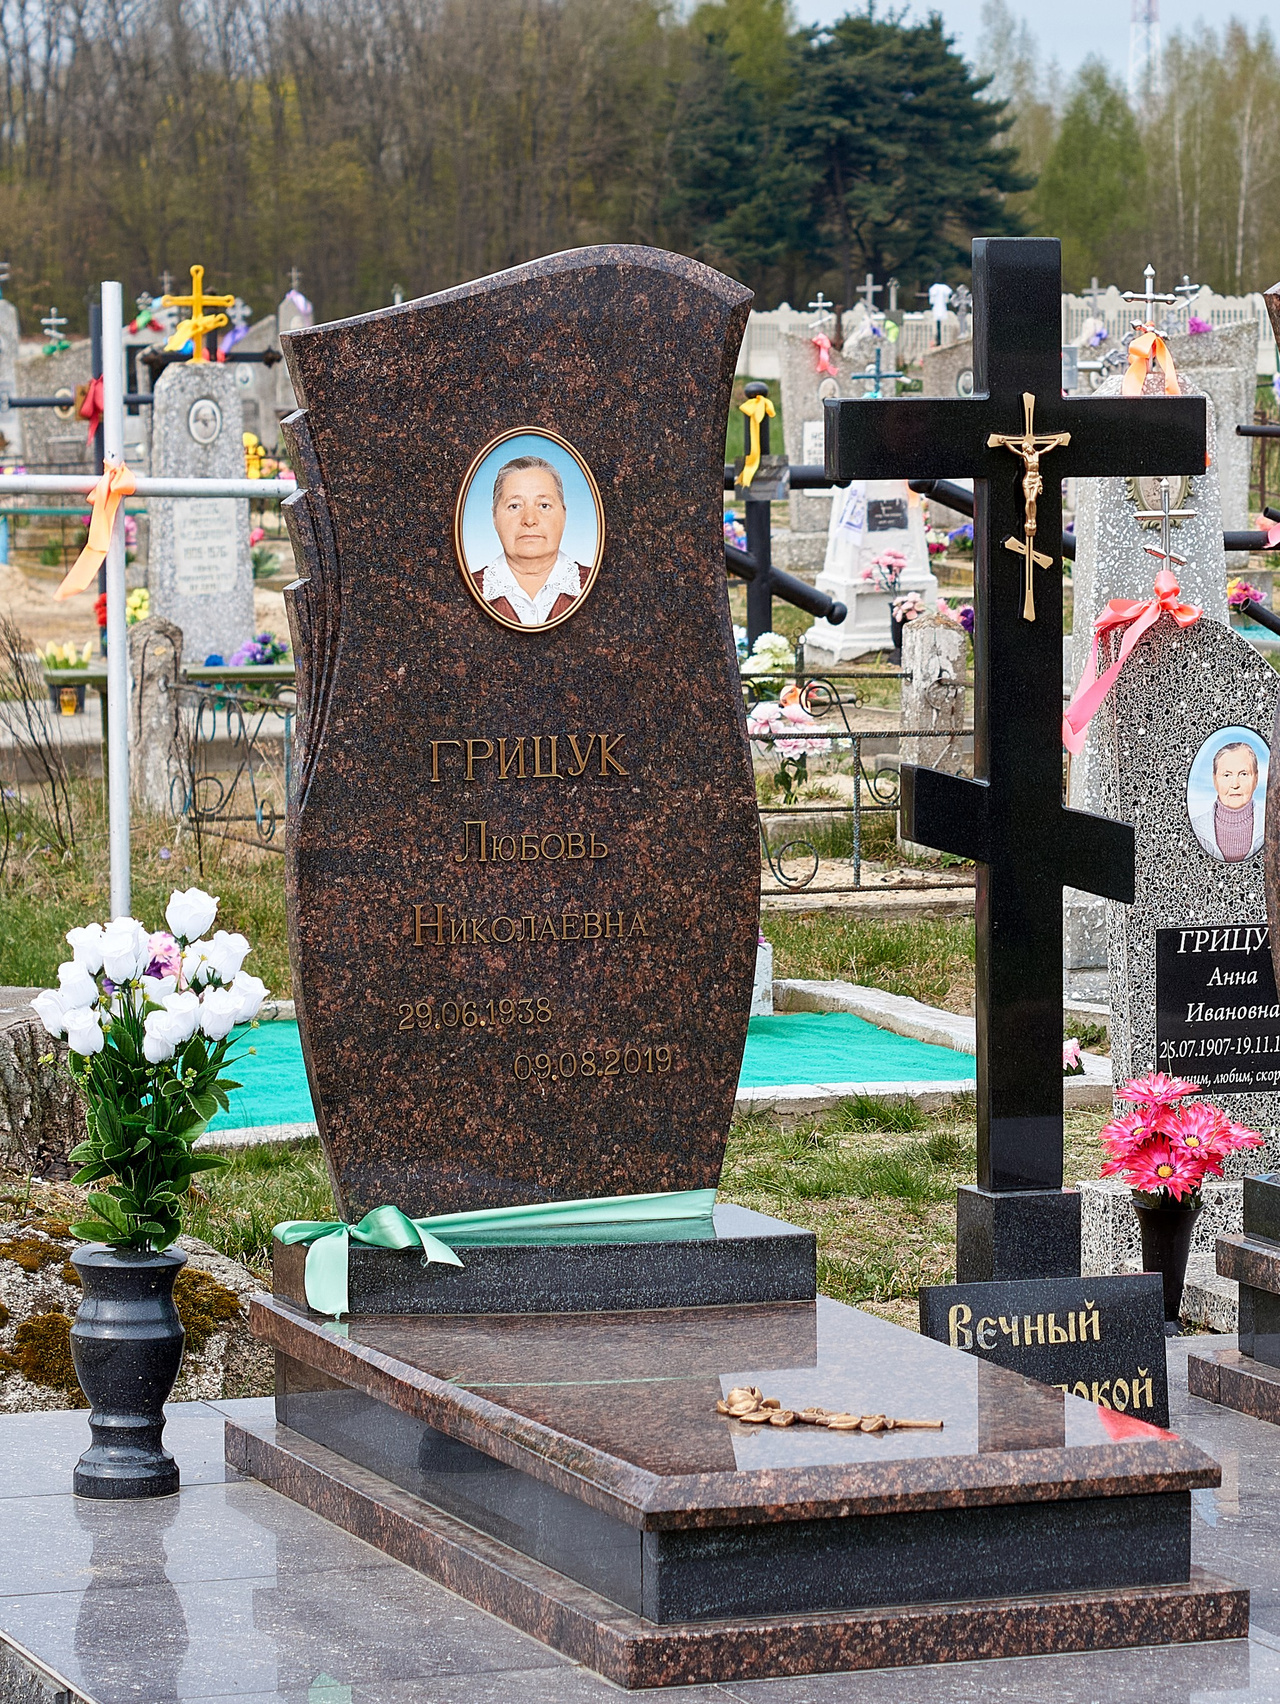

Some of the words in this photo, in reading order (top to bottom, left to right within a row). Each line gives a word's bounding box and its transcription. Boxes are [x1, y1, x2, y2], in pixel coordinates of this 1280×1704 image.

[429, 733, 630, 783] ГРИЦУК
[1177, 927, 1272, 956] ГРИЦУ
[1206, 966, 1259, 987] Анна
[398, 997, 554, 1031] 29.06.1938
[1184, 1002, 1280, 1023] Ивановна
[513, 1047, 673, 1082] 09.08.2019
